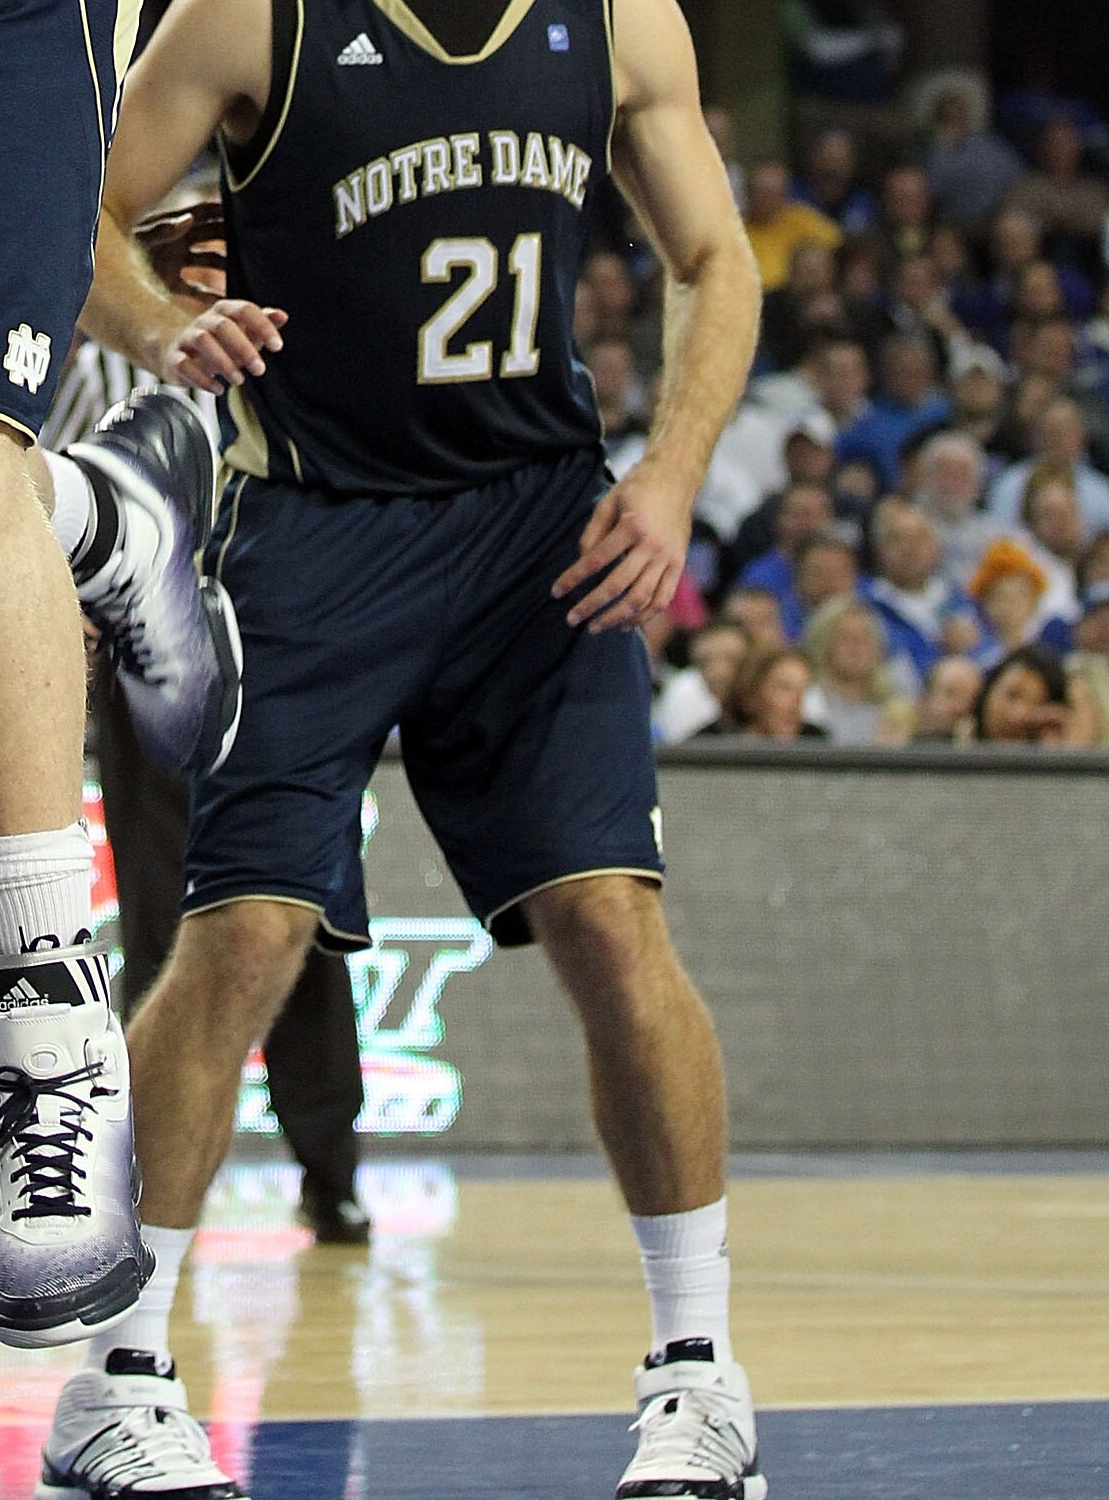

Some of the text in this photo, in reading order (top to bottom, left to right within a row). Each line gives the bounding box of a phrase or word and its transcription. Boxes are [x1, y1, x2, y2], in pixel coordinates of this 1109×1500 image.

[332, 129, 593, 241] NOTRE DAME
[416, 231, 543, 385] 21
